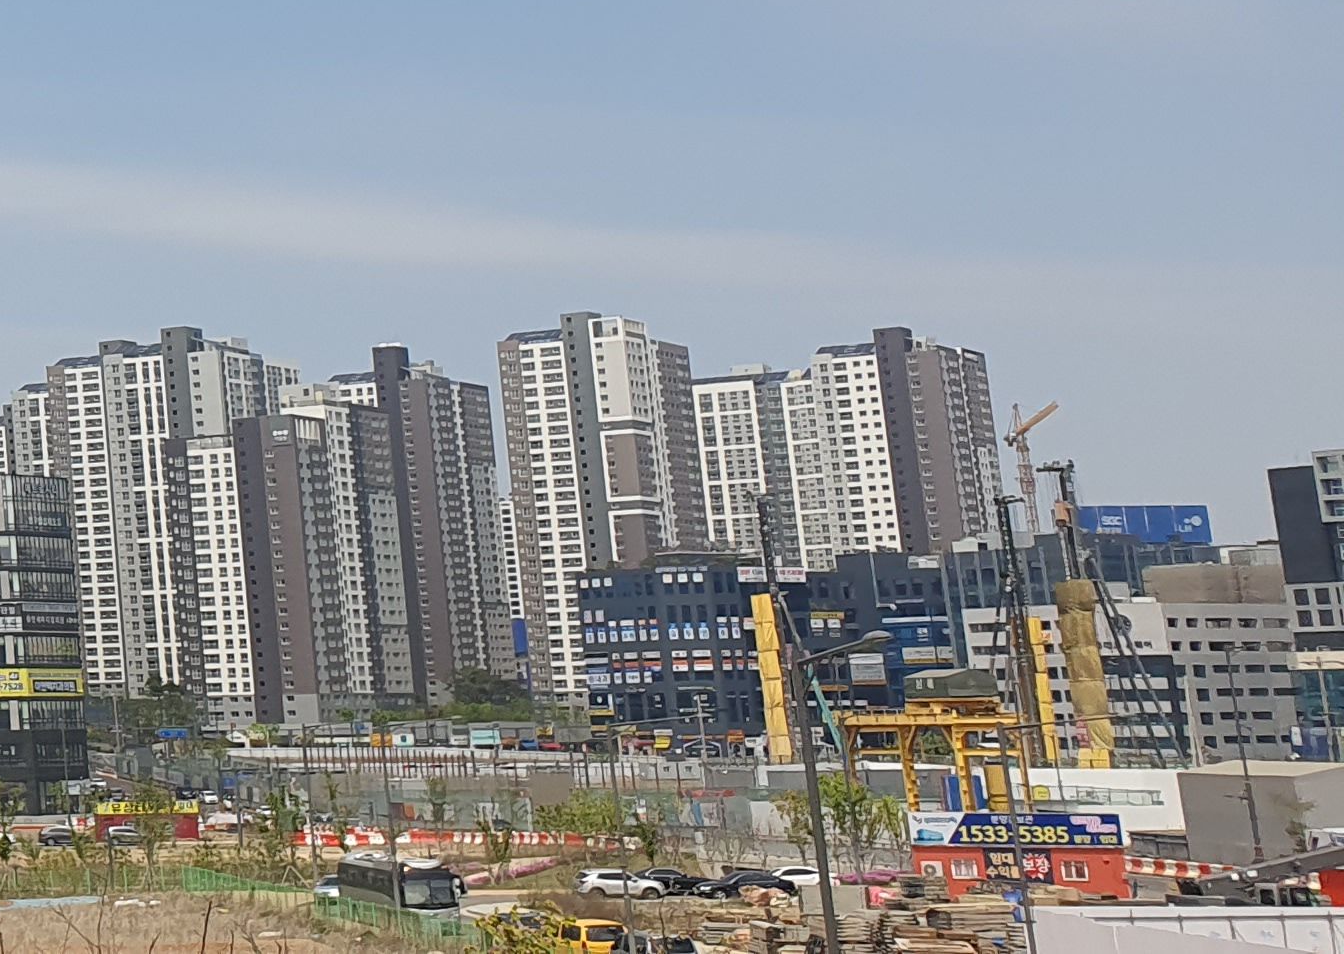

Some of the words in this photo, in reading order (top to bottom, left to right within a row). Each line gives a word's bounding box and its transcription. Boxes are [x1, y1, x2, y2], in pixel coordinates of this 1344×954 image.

[959, 825, 1070, 844] 1533-5385
[988, 852, 1015, 866] 임대
[1023, 857, 1051, 874] 보장
